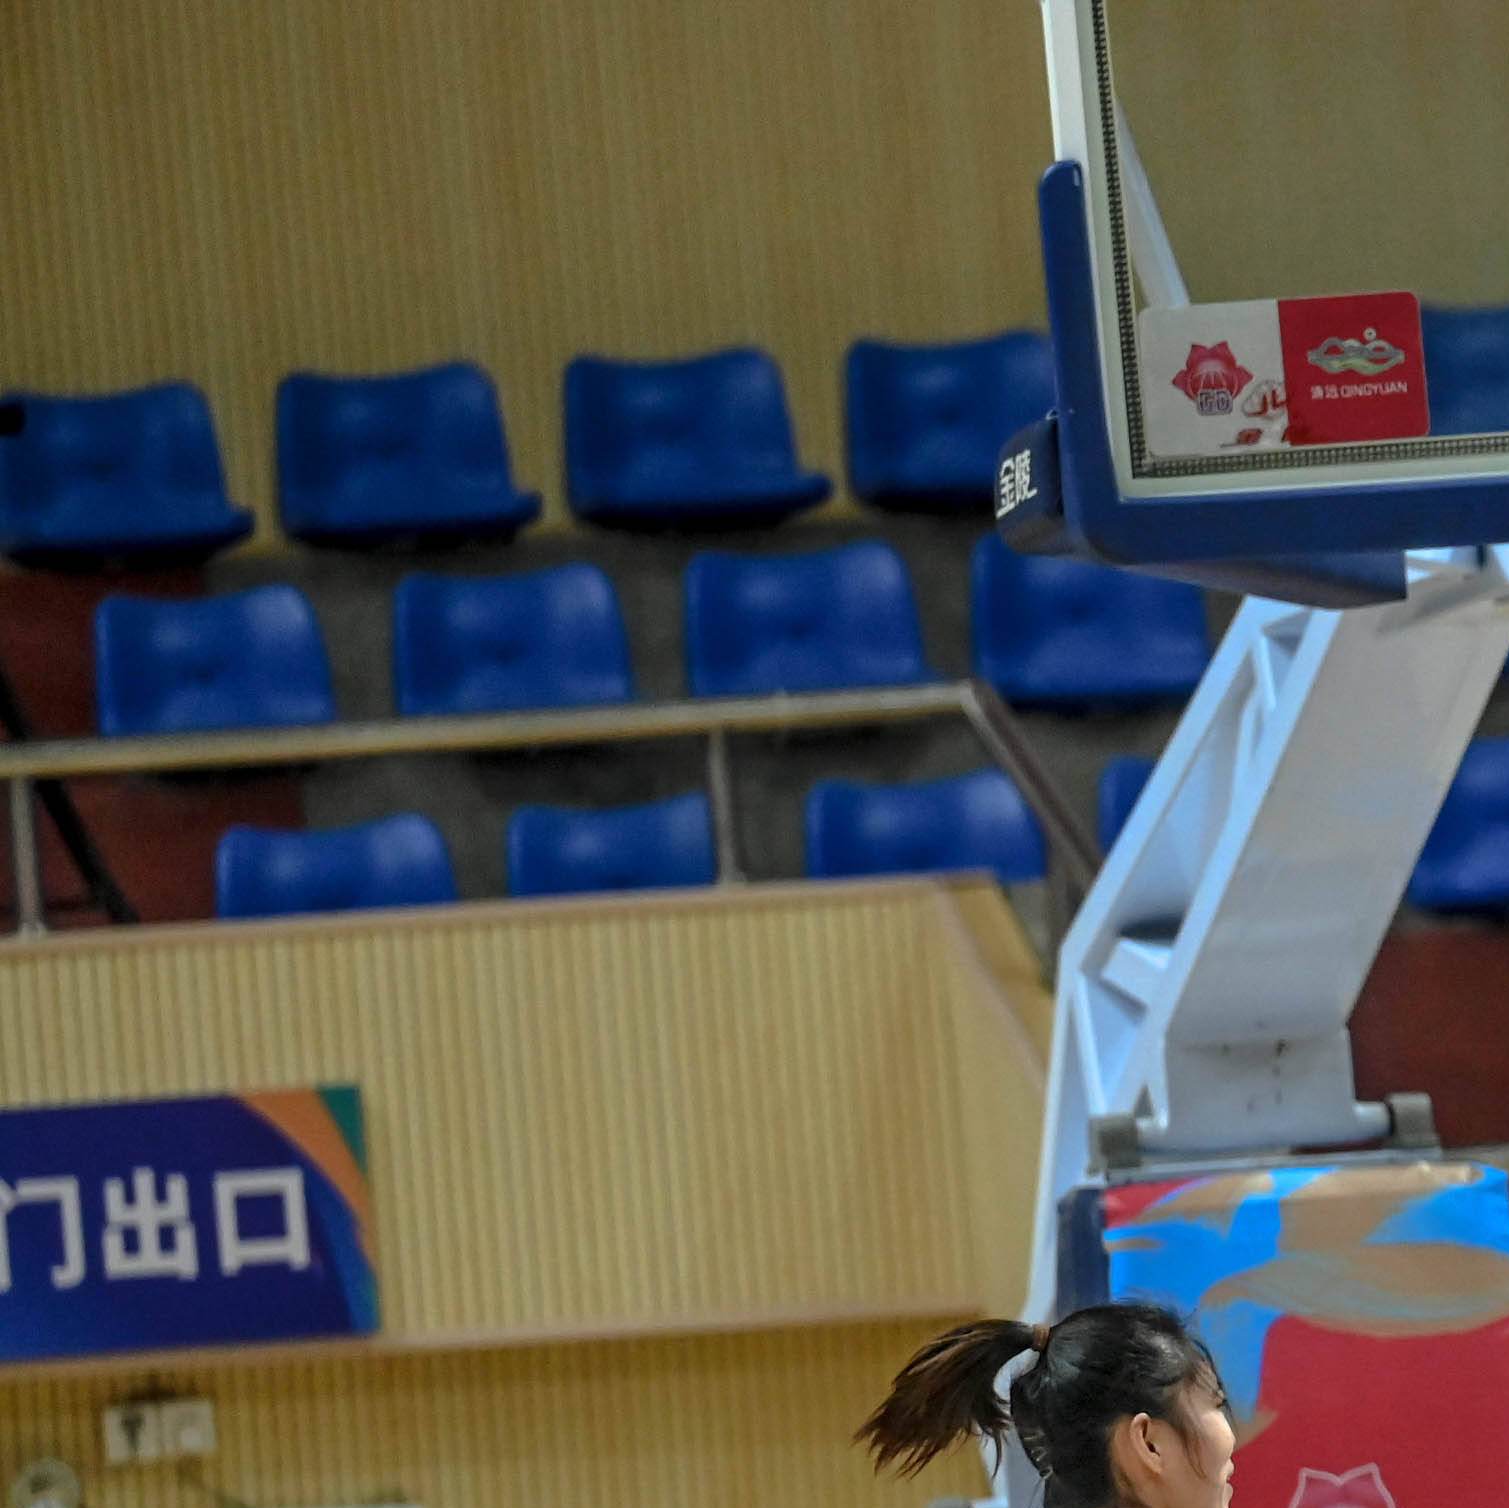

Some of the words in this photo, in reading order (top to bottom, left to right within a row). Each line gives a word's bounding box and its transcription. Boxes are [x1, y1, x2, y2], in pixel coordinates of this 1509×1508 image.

[995, 448, 1038, 519] 金陵
[0, 1166, 311, 1294] 门出口
